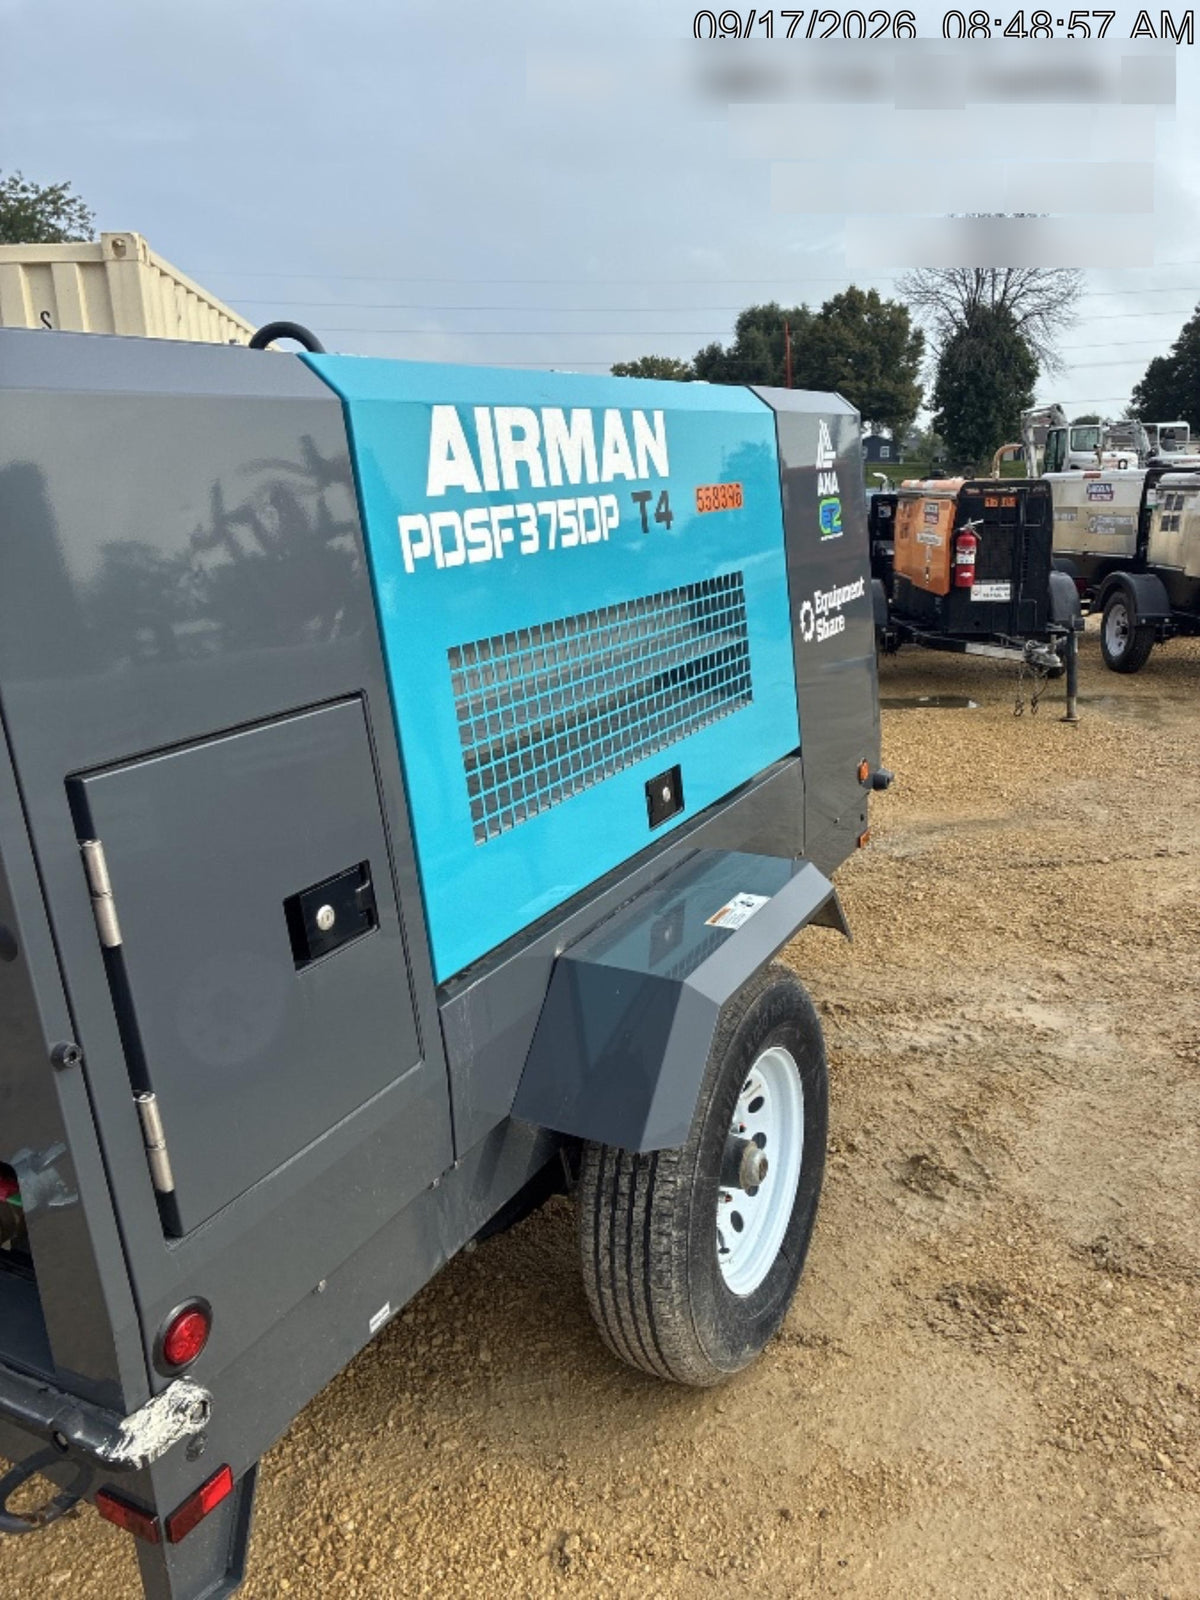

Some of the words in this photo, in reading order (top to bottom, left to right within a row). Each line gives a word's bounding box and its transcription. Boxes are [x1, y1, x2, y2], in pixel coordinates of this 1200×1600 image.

[426, 404, 670, 497] AIRMAN
[398, 494, 620, 574] PDSF375DP
[631, 490, 675, 534] T4
[814, 575, 865, 616] Equipment
[816, 614, 846, 642] Share
